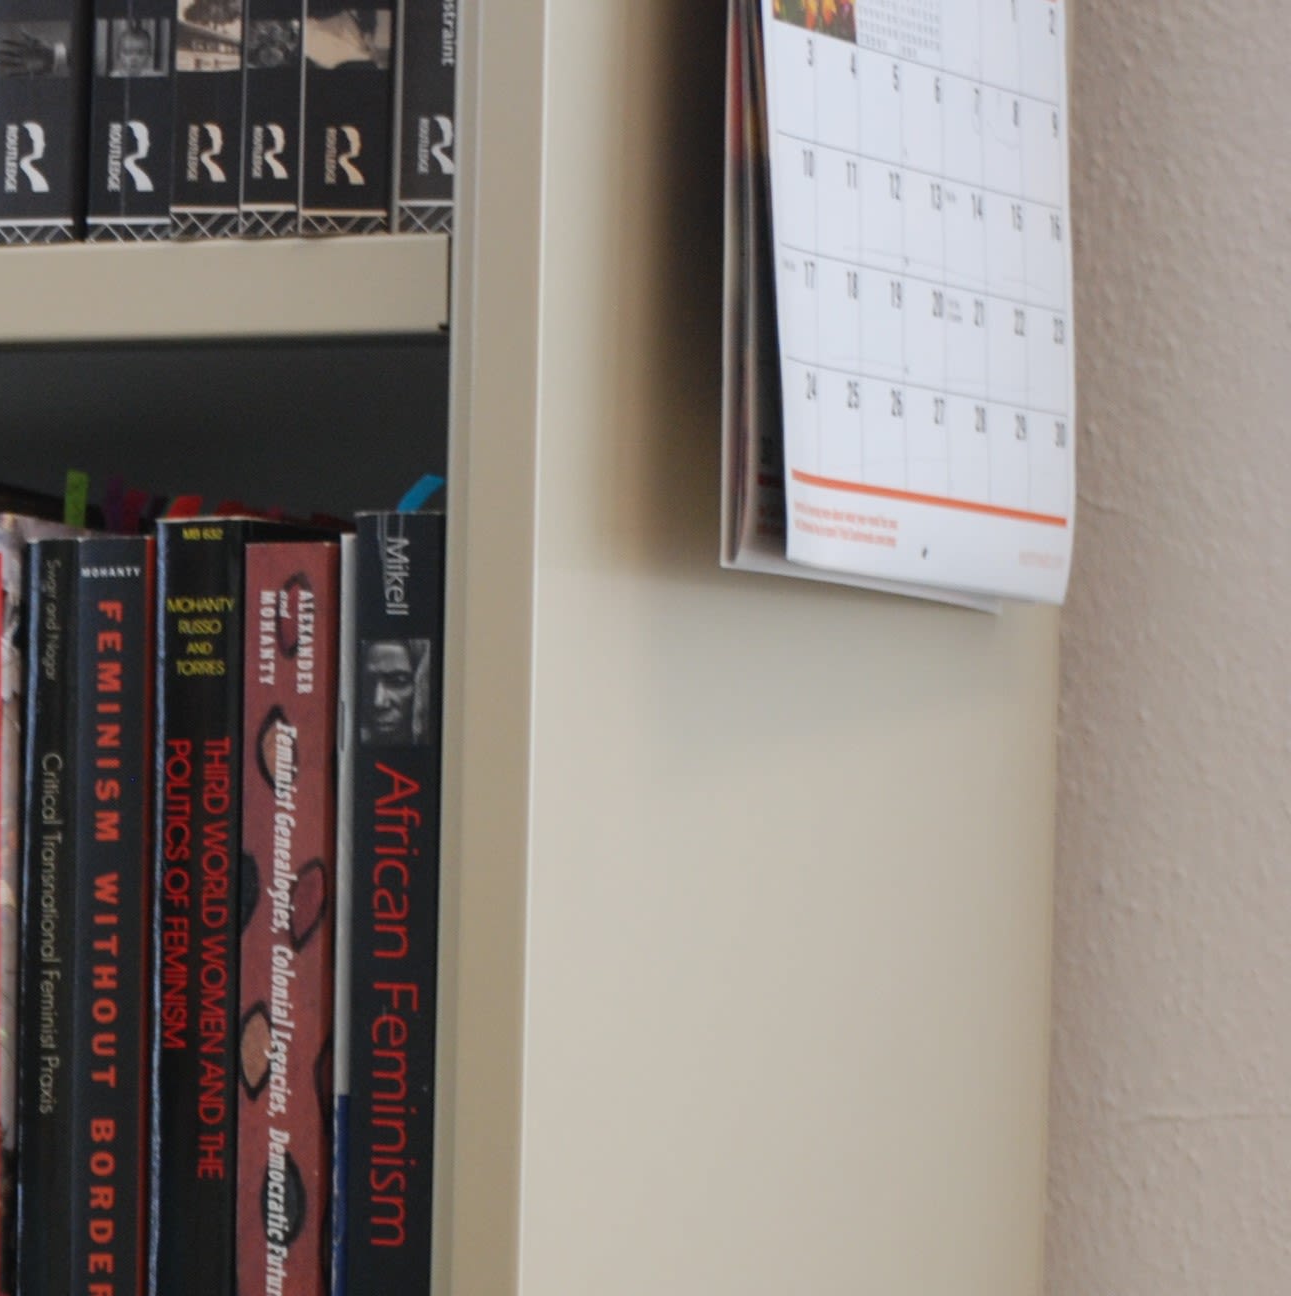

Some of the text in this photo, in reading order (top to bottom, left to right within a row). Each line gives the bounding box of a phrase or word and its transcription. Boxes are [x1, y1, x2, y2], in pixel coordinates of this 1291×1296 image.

[5, 124, 18, 192] ROUTLEDGE
[108, 122, 121, 192] ROUTLEDGE
[383, 538, 411, 616] Mikell
[257, 590, 275, 686] MOHANTY
[296, 590, 314, 694] ALEXANDER
[95, 600, 122, 843] FEMINISM
[270, 719, 296, 808] Feminist
[162, 740, 191, 1047] POLITICS OF FEMINISM
[268, 814, 296, 934] Genealogies,
[37, 752, 63, 1114] Critical Transnational Feminist Praxis
[91, 874, 120, 1089] WITHOUT
[196, 738, 229, 1179] THIRD WORLD WOMEN AND THE
[268, 945, 293, 1027] Colonial
[368, 760, 421, 1248] African Feminism
[266, 1033, 292, 1118] Legacies,
[265, 1128, 290, 1237] Democratic
